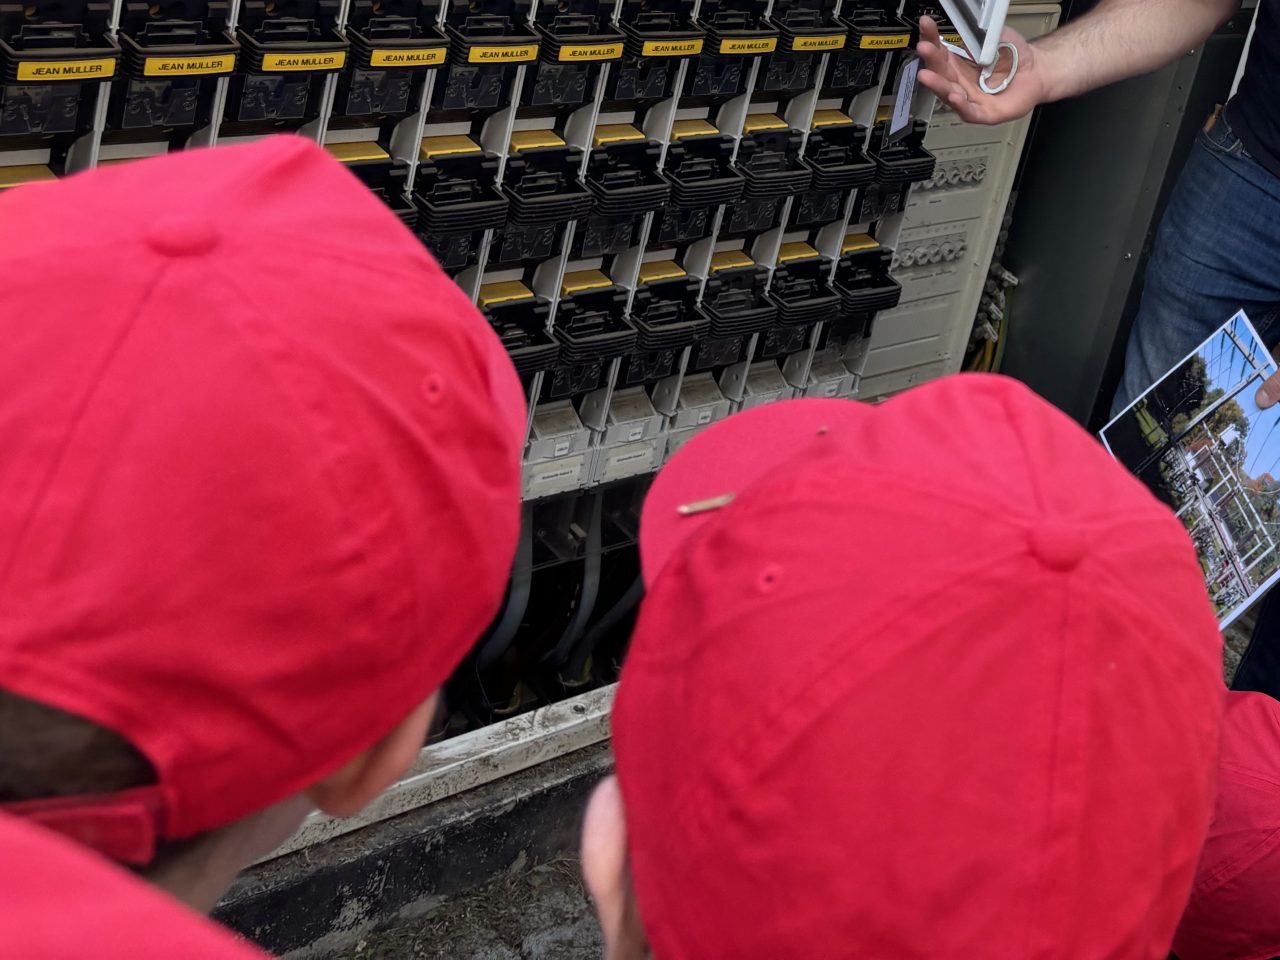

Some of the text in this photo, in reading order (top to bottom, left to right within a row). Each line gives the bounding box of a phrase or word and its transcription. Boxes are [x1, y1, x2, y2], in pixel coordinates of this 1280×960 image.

[383, 54, 404, 62] JEAN
[158, 63, 184, 71] JEAN
[275, 59, 299, 67] JEAN
[32, 67, 60, 75] JEAN
